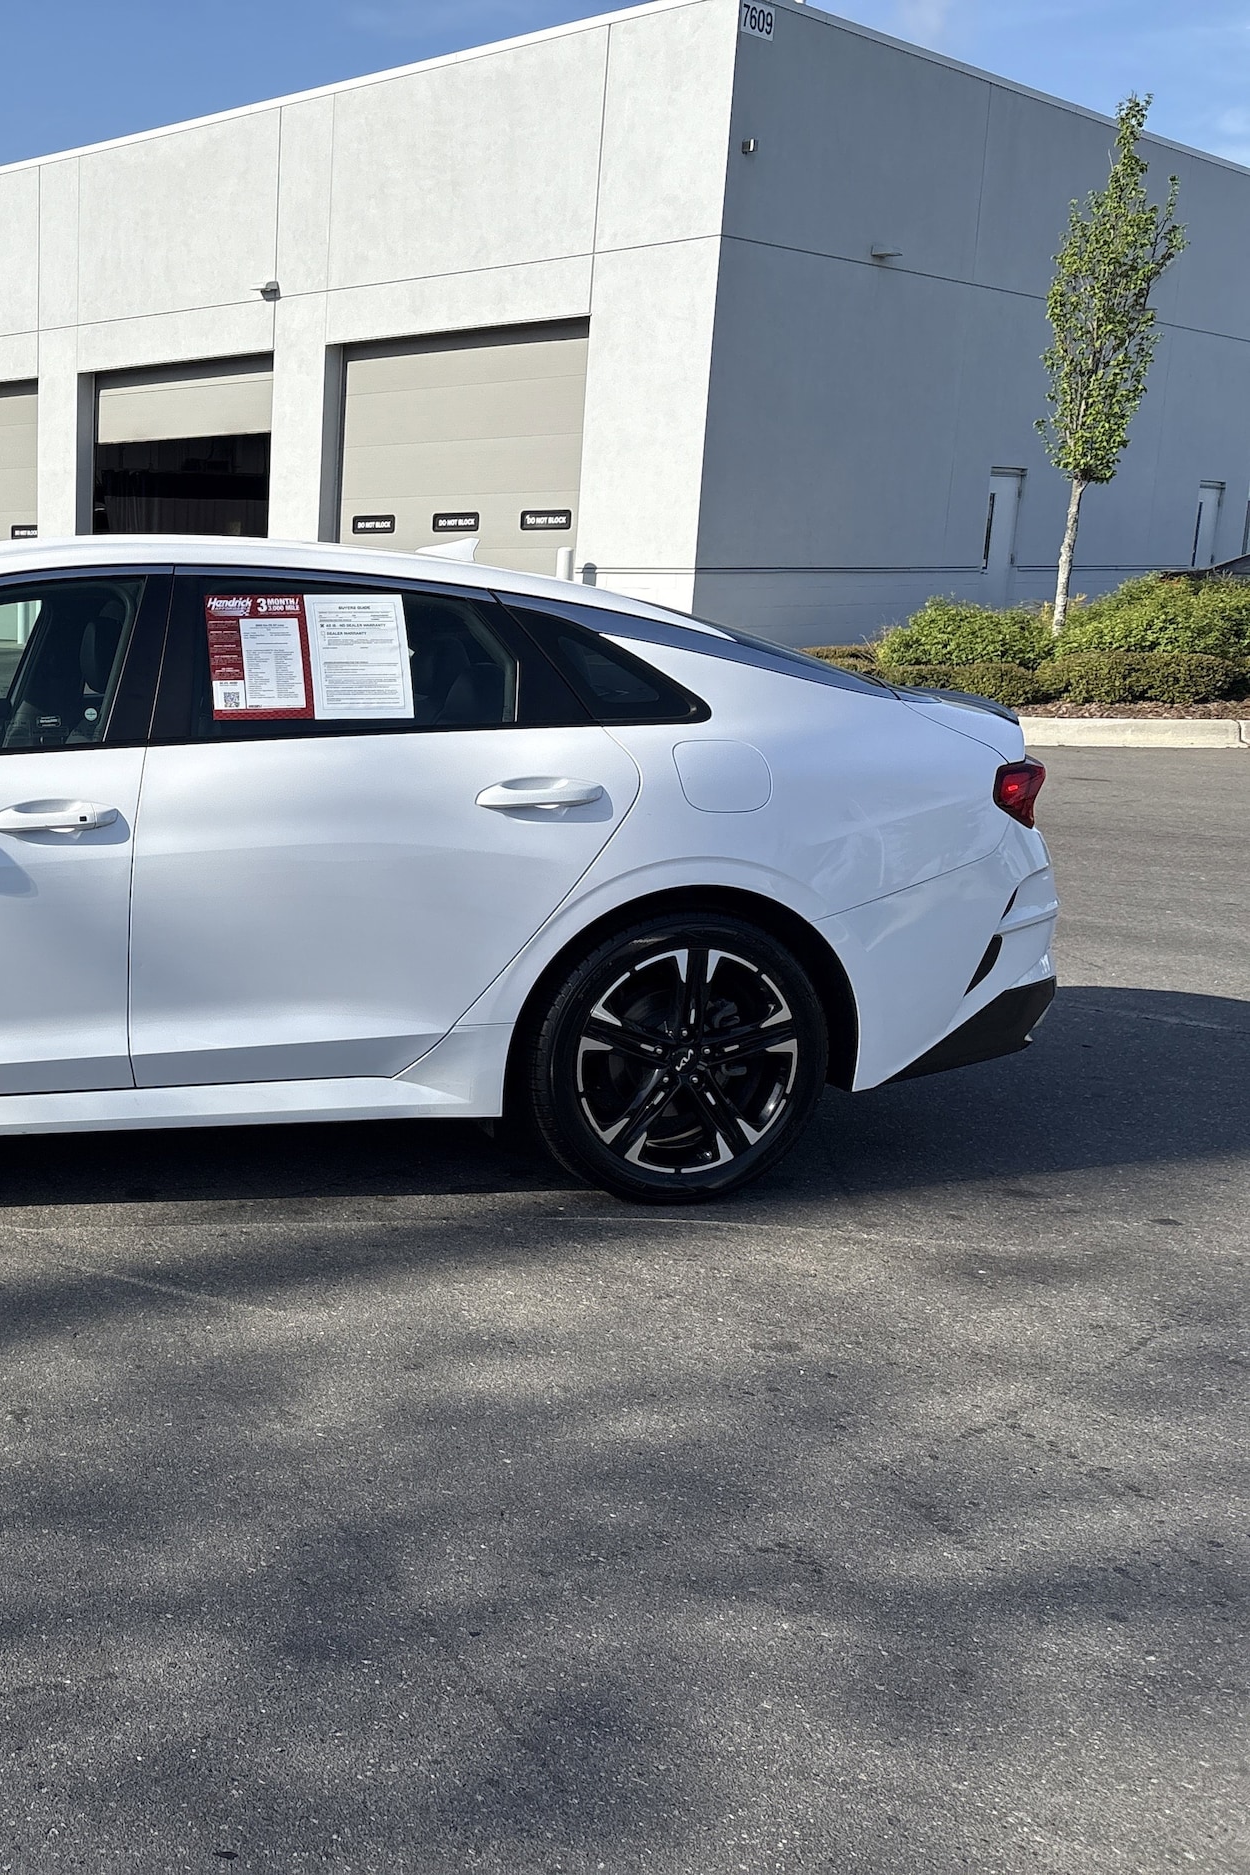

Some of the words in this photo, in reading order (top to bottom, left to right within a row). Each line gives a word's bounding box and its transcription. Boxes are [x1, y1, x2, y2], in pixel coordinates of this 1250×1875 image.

[743, 3, 773, 35] 7609
[357, 521, 365, 529] DO
[375, 520, 391, 528] BLOCK
[457, 518, 475, 526] BLOCK
[526, 516, 535, 524] DO
[535, 516, 547, 524] NOT
[547, 515, 566, 524] BLOCK
[207, 597, 252, 611] Hendrick
[257, 597, 268, 612] 3
